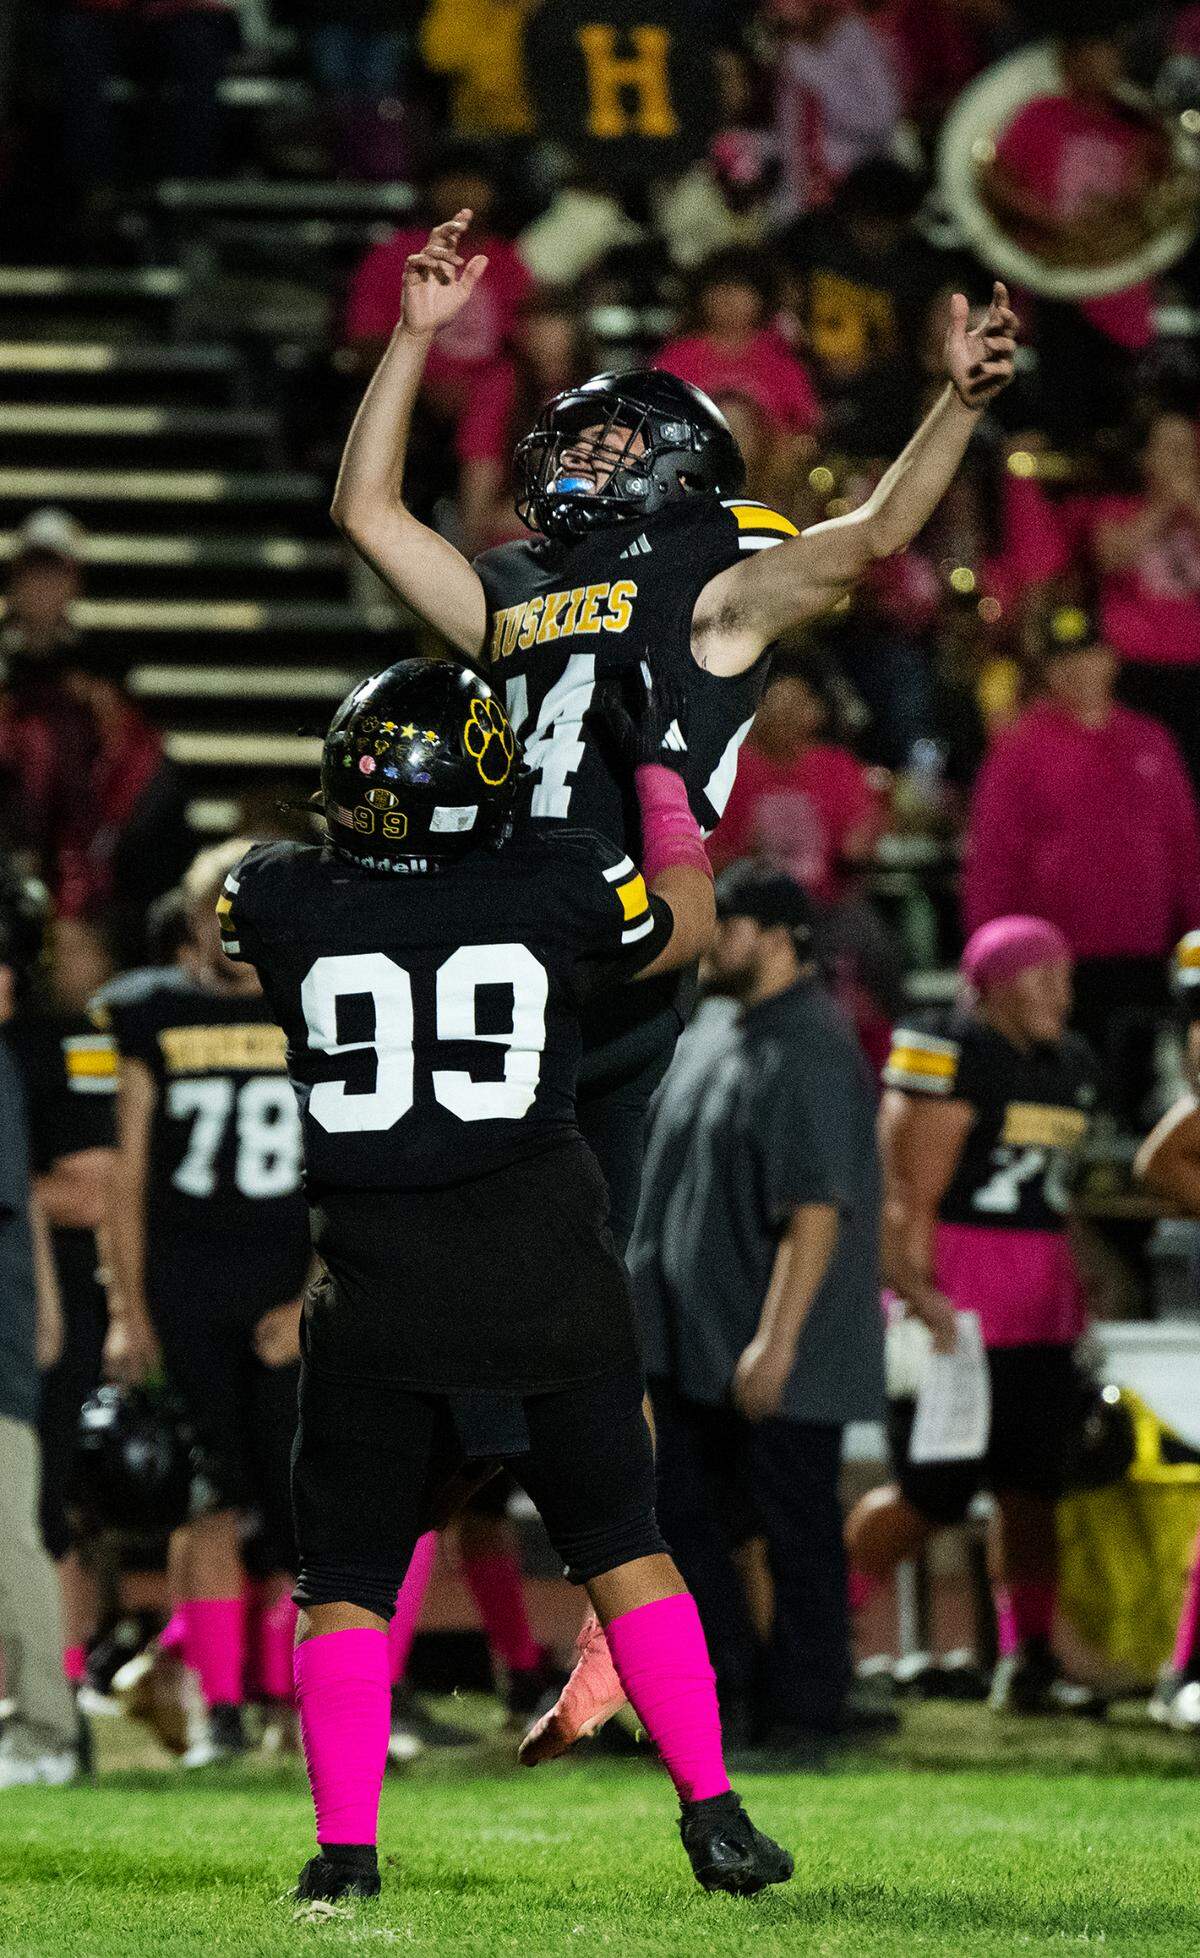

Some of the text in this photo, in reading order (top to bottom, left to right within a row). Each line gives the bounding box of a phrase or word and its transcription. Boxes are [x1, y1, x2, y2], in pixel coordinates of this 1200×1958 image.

[579, 23, 679, 136] H
[505, 653, 596, 819] 4
[353, 806, 408, 840] 99
[301, 943, 549, 1133] 99
[168, 1077, 301, 1197] 78
